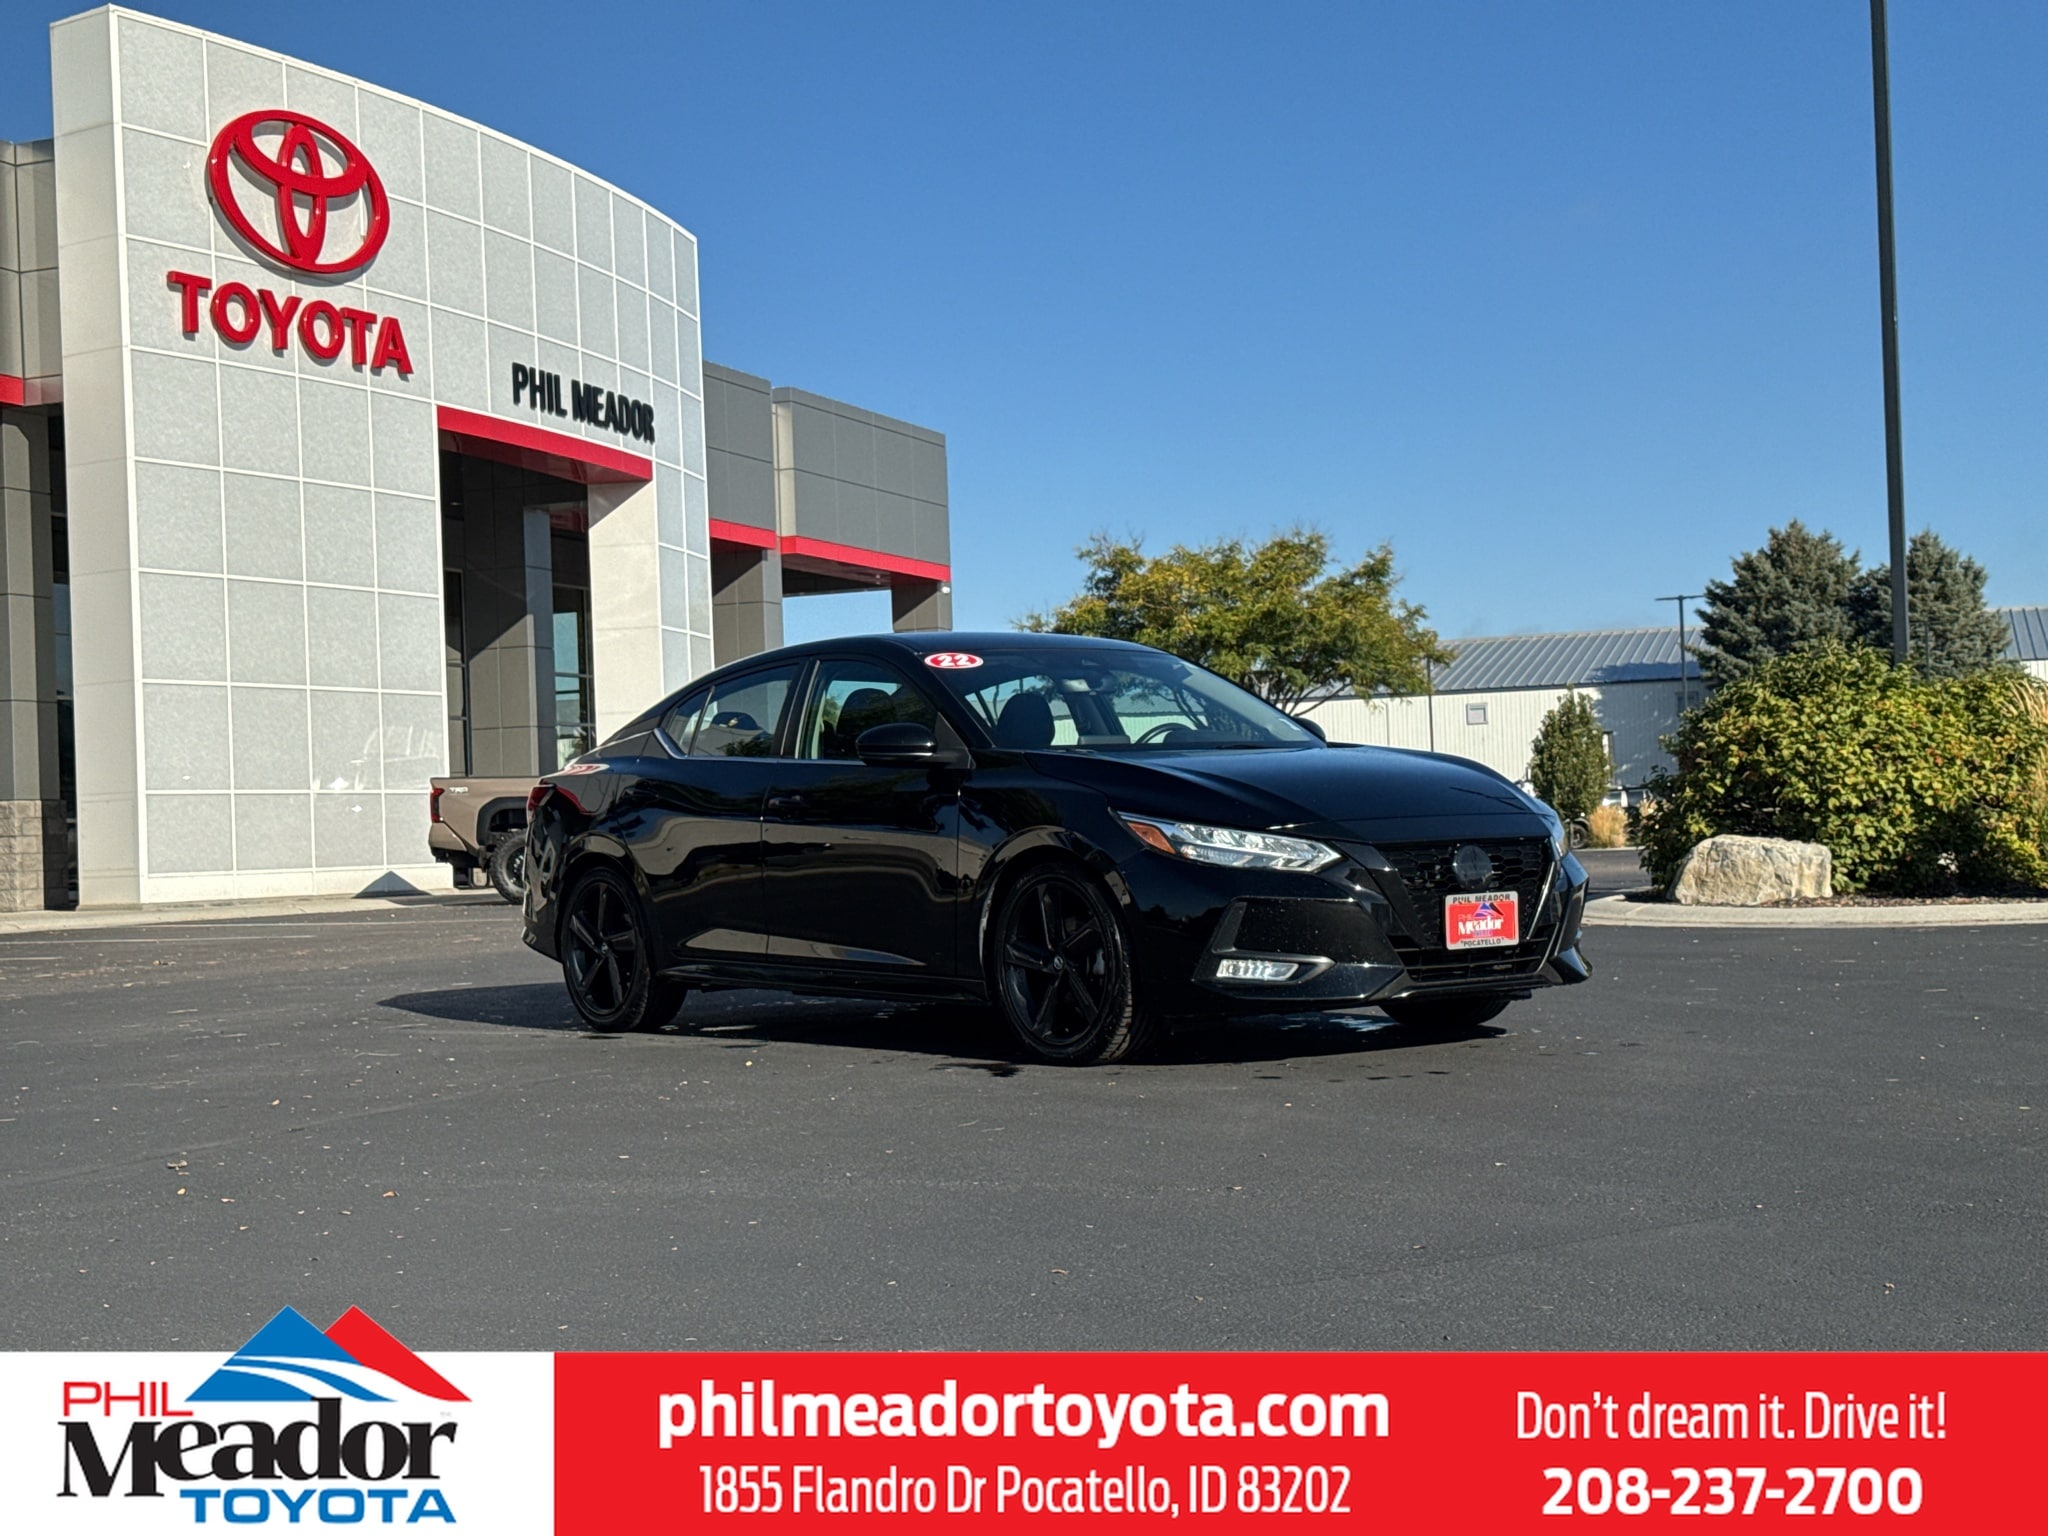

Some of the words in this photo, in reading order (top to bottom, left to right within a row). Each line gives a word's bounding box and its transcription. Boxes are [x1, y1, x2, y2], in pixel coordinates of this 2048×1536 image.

[167, 271, 413, 374] TOYOTA
[512, 362, 567, 417] PHIL
[571, 379, 655, 445] MEADOR
[937, 654, 971, 667] 22
[1475, 893, 1511, 902] MEADOR
